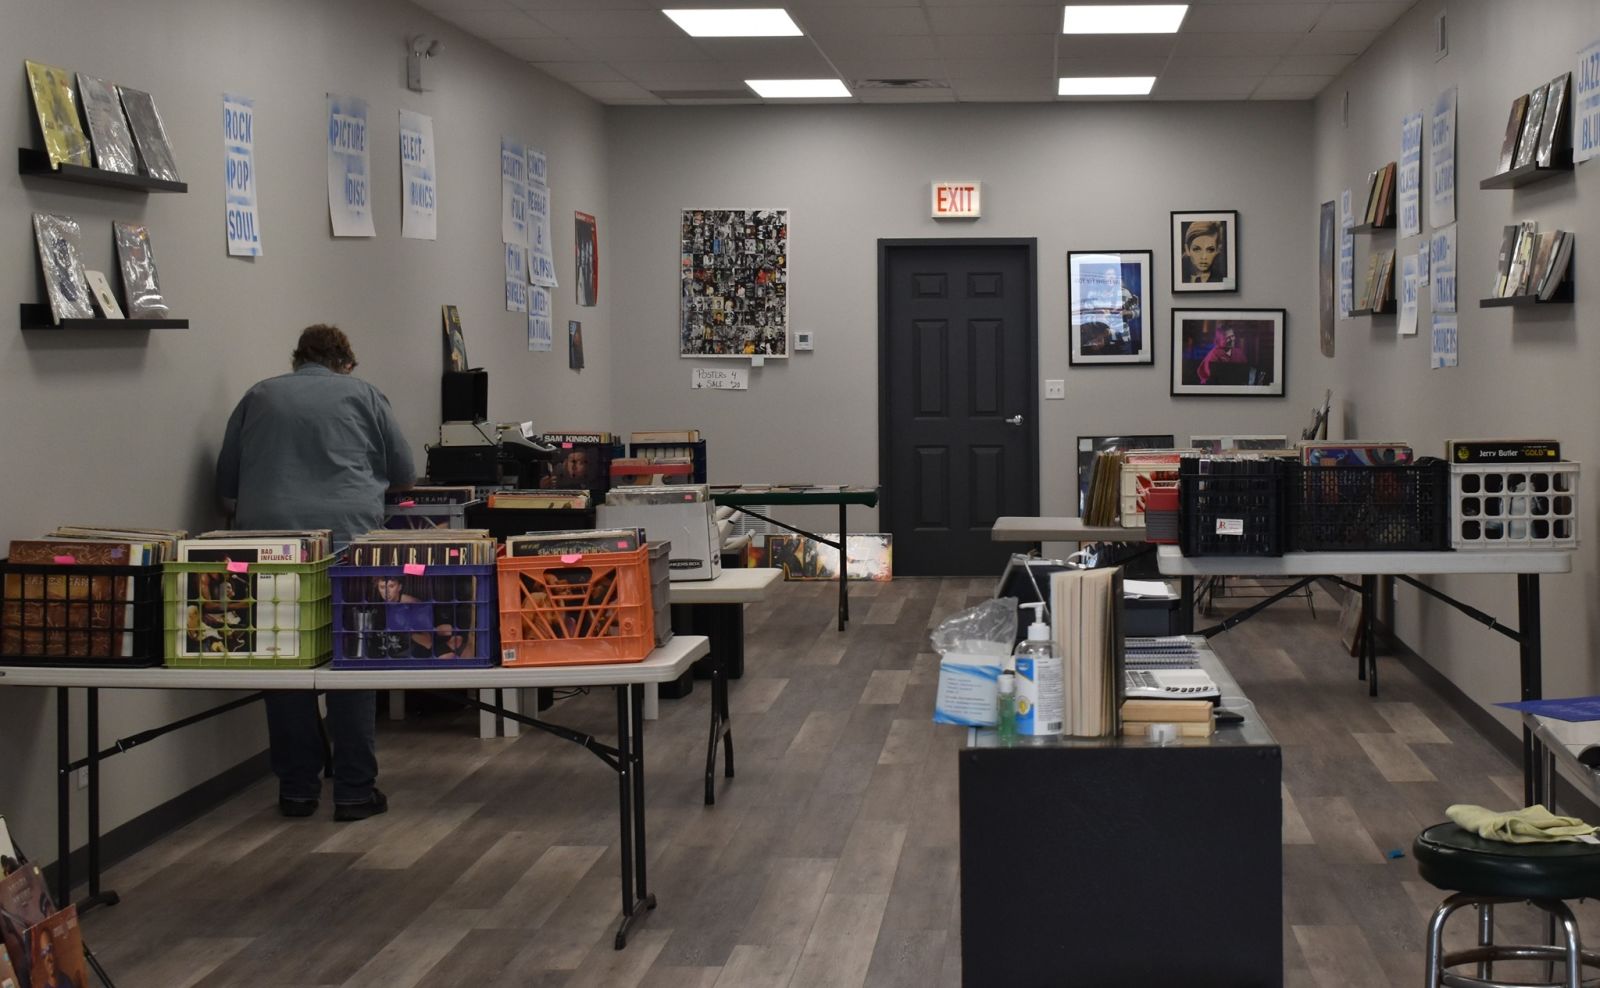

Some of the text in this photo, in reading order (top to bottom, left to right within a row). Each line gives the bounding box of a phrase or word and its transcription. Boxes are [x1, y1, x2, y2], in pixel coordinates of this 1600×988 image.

[225, 108, 251, 144] ROCK
[332, 119, 365, 152] PICTURE
[402, 134, 425, 162] ELECT-
[230, 160, 249, 191] POP
[503, 154, 524, 182] COUNTRY
[348, 179, 365, 207] DISC
[937, 186, 975, 212] EXIT
[228, 209, 258, 242] SOUL
[706, 379, 722, 388] SALE
[544, 434, 600, 443] SAM KINISON
[1498, 449, 1519, 457] Butler
[354, 547, 468, 567] CHARLIE
